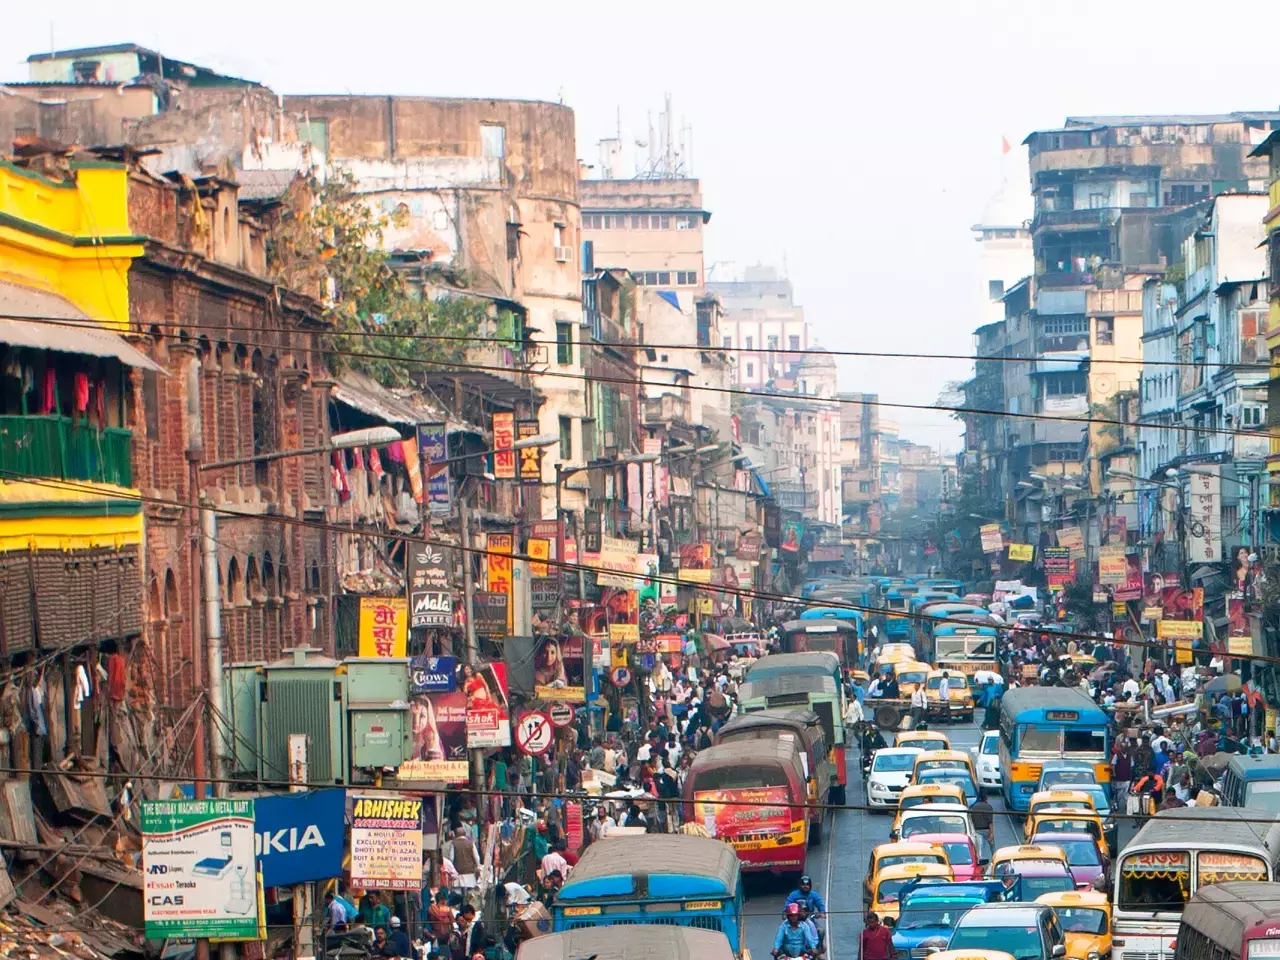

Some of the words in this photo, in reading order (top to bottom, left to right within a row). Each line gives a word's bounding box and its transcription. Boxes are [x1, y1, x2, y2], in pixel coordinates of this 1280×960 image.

[415, 593, 450, 613] Mala
[414, 616, 451, 625] SAREES
[414, 671, 449, 686] CROWN
[467, 714, 494, 723] shok
[144, 803, 155, 815] THE
[155, 803, 176, 815] BOMBAY
[178, 802, 209, 814] MACHINERY
[215, 801, 233, 814] METAL
[235, 801, 249, 813] MART
[354, 799, 421, 819] ABHISHEK
[211, 823, 232, 833] Jubilee
[150, 865, 168, 875] AND
[151, 881, 175, 889] Essae
[176, 880, 197, 889] Teraoka
[151, 896, 184, 906] CAS
